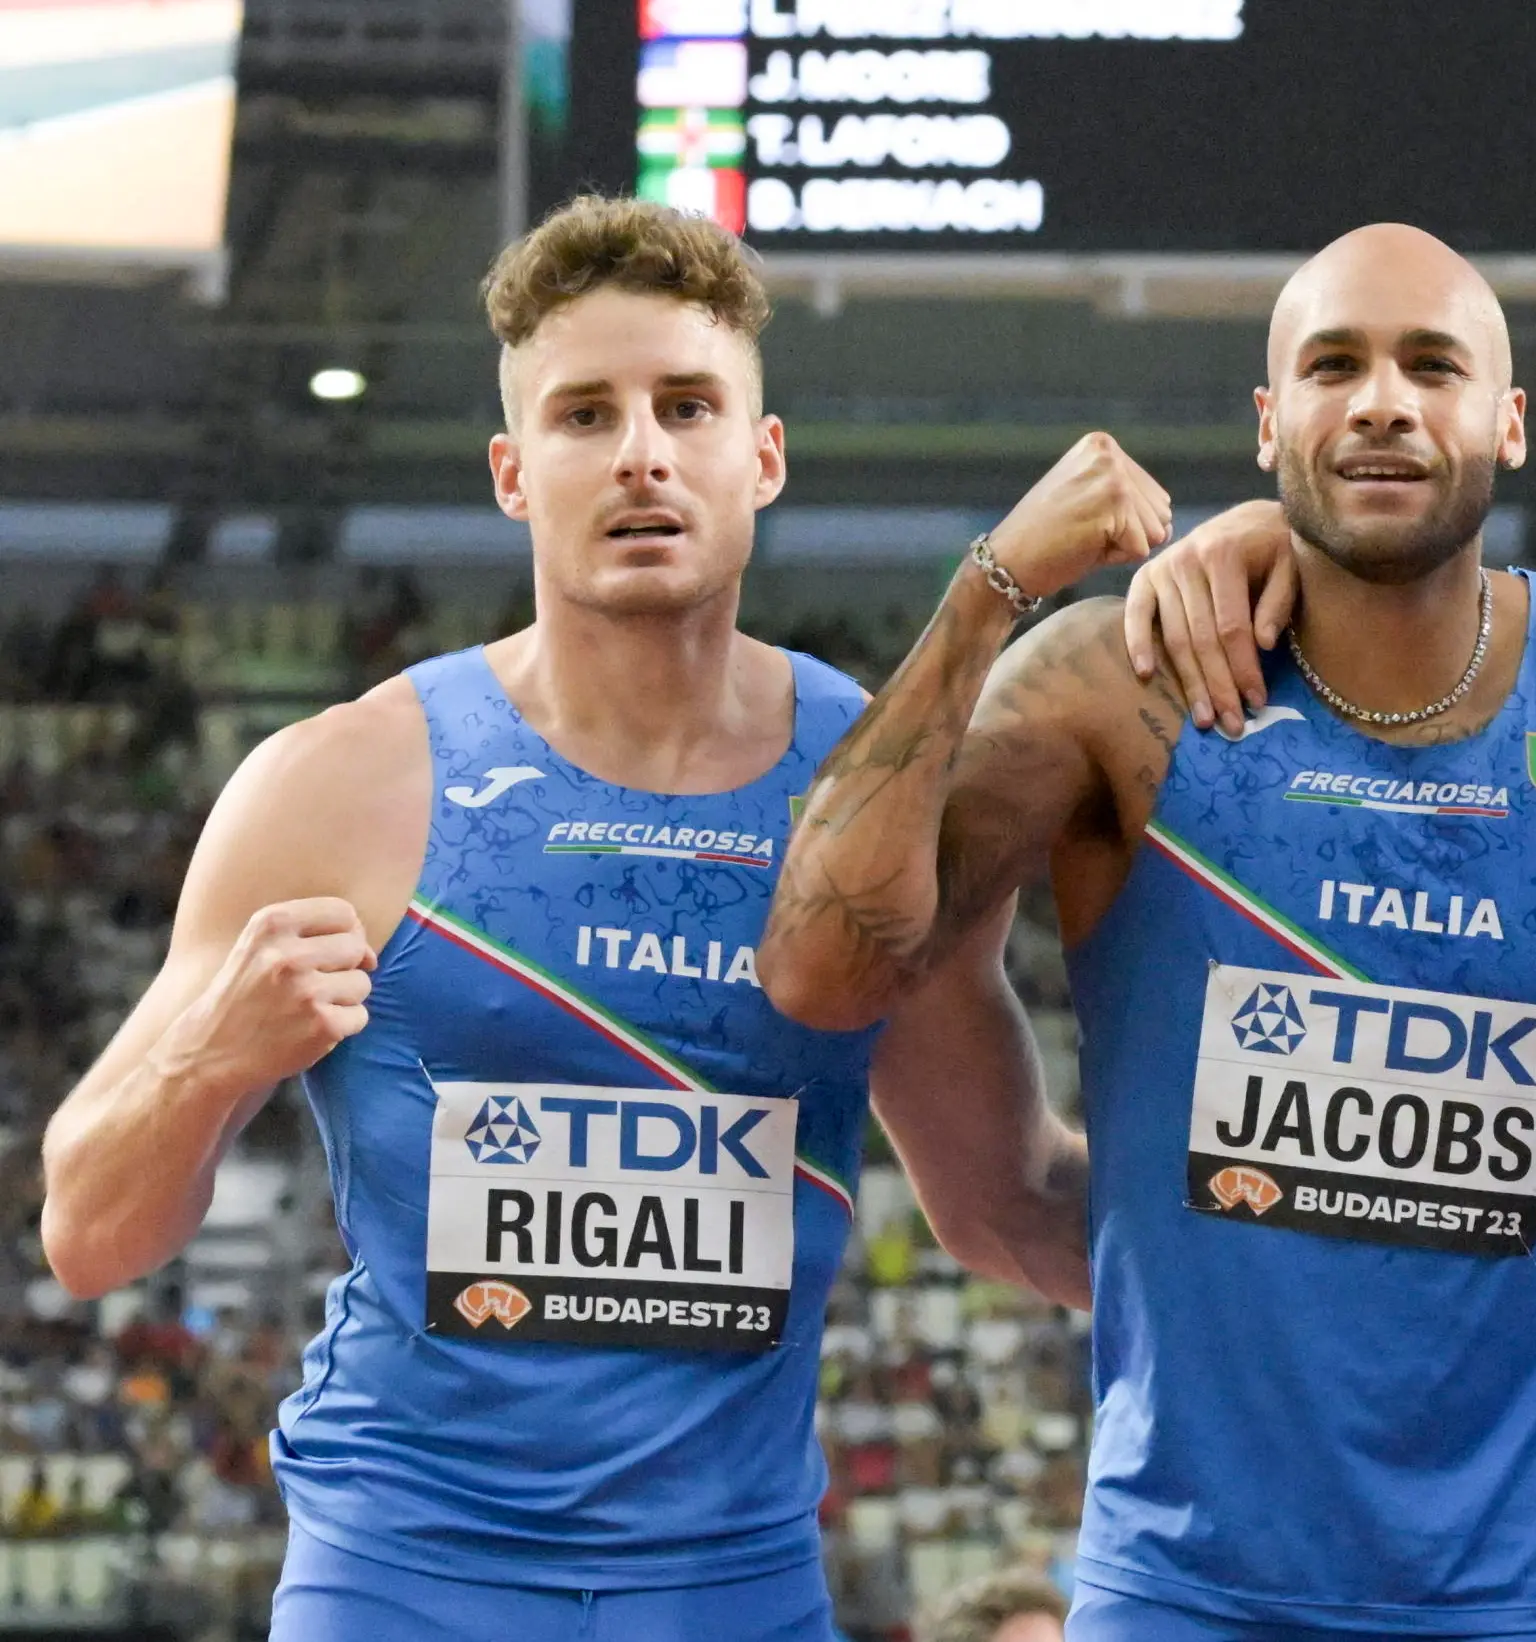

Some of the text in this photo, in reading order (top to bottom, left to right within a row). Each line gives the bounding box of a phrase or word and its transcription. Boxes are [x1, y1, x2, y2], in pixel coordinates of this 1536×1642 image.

[1290, 770, 1509, 807] FRECCIAROSSA
[548, 822, 774, 858] FRECCIAROSSA
[1318, 879, 1504, 940] ITALIA
[576, 925, 763, 988] ITALIA
[540, 1096, 772, 1180] TDK
[1215, 1075, 1535, 1182] JACOBS
[485, 1188, 745, 1275] RIGALI
[1293, 1185, 1522, 1236] BUDAPEST 23
[543, 1294, 772, 1332] BUDAPEST 23
